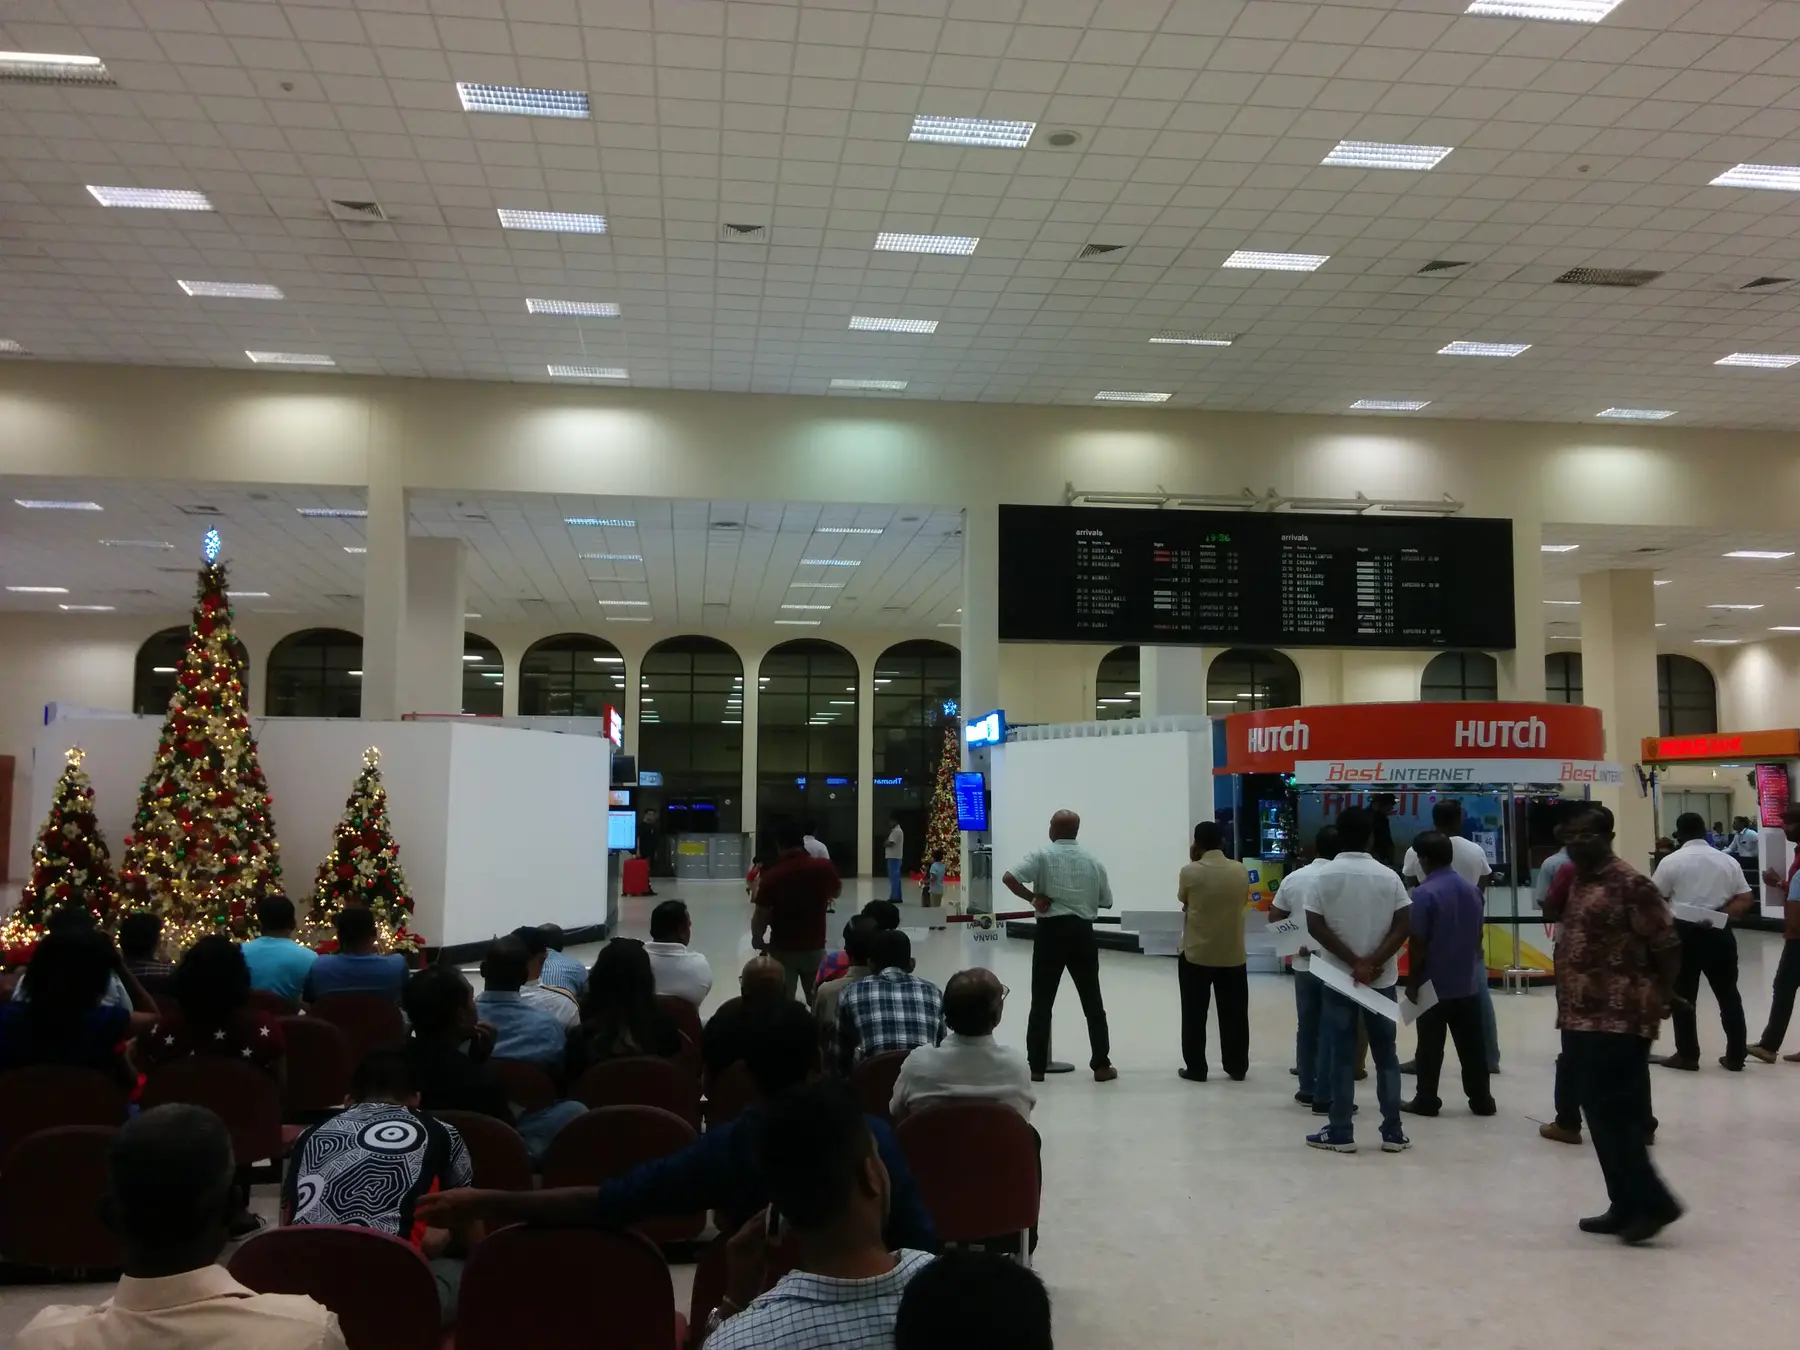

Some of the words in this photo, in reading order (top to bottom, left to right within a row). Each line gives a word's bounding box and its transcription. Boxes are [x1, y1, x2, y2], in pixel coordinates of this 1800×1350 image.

[1325, 762, 1388, 782] Best
[1389, 768, 1475, 781] INTERNET
[1558, 762, 1600, 782] Best
[973, 934, 998, 942] DIANA
